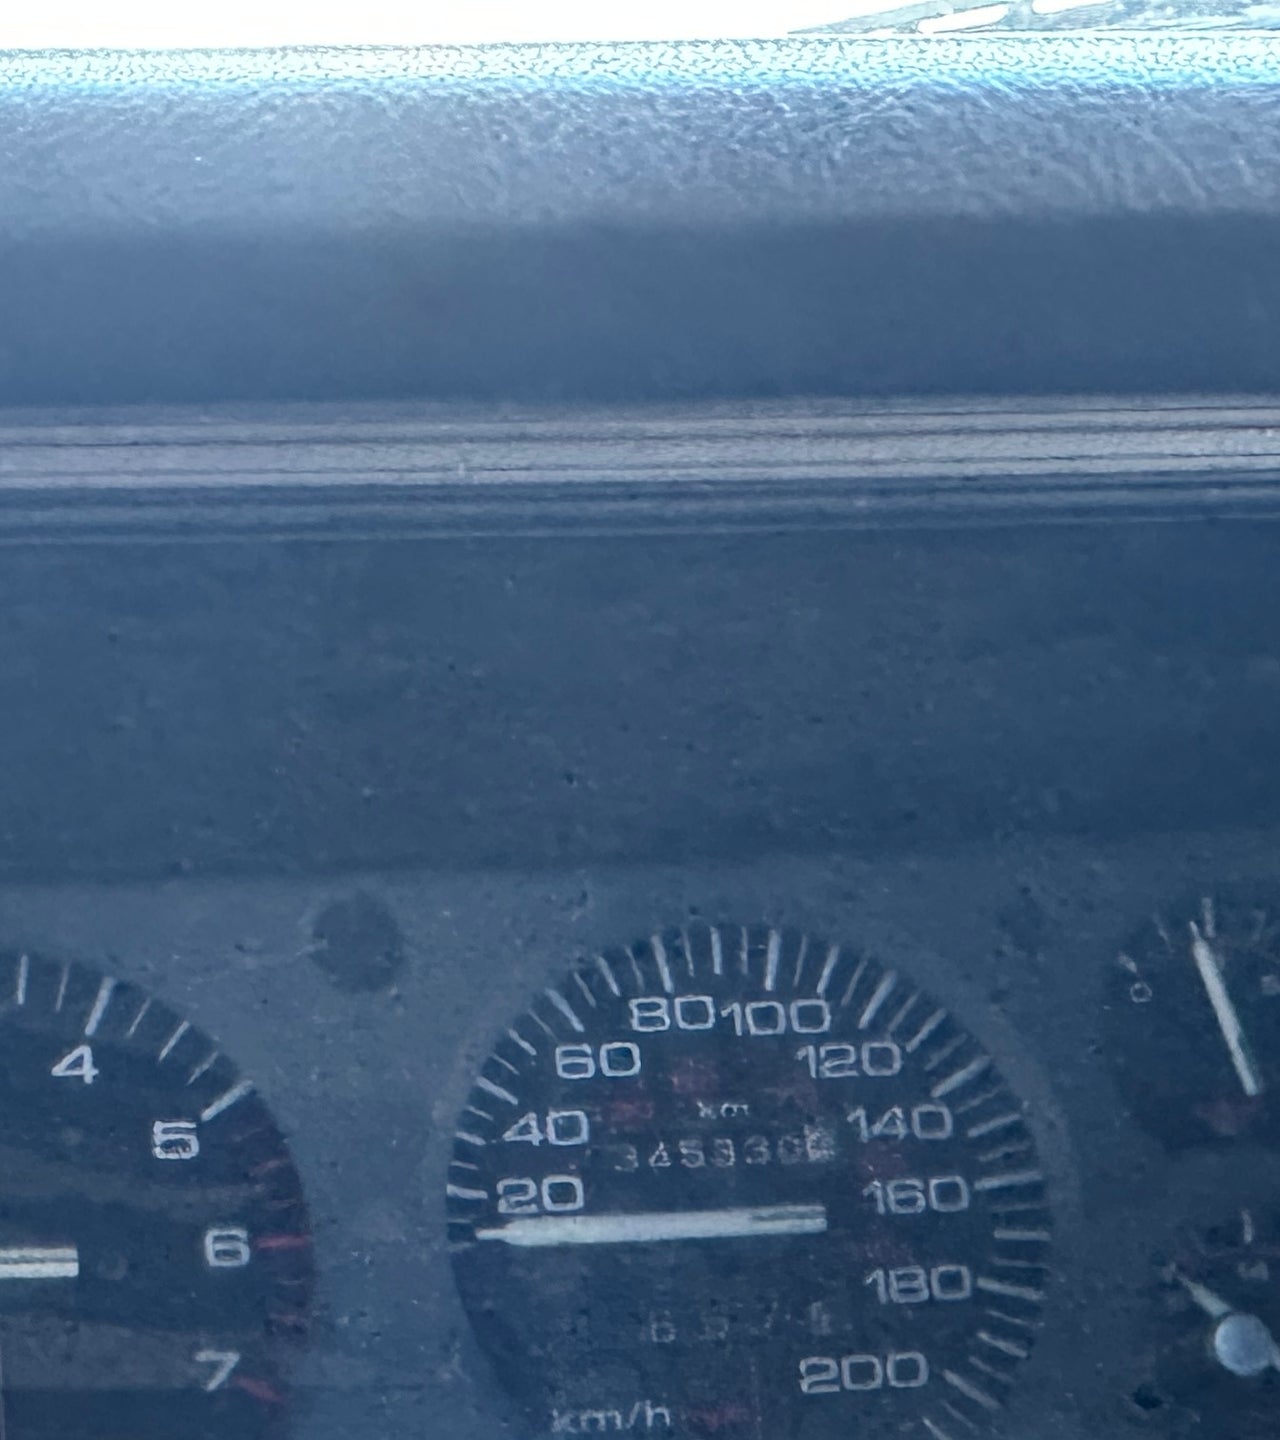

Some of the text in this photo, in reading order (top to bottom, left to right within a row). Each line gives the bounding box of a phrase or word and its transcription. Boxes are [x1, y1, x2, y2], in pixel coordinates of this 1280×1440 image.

[629, 995, 717, 1034] 80
[720, 998, 832, 1037] 100
[51, 1045, 99, 1085] 4
[554, 1040, 641, 1080] 60
[795, 1040, 902, 1080] 120
[151, 1120, 200, 1160] 5
[500, 1109, 590, 1147] 40
[845, 1103, 953, 1143] 140
[495, 1174, 585, 1214] 20
[861, 1175, 970, 1215] 160
[203, 1227, 250, 1268] 6
[862, 1264, 971, 1304] 180
[194, 1350, 241, 1391] 7
[798, 1352, 929, 1395] 200
[550, 1399, 672, 1434] km/h
